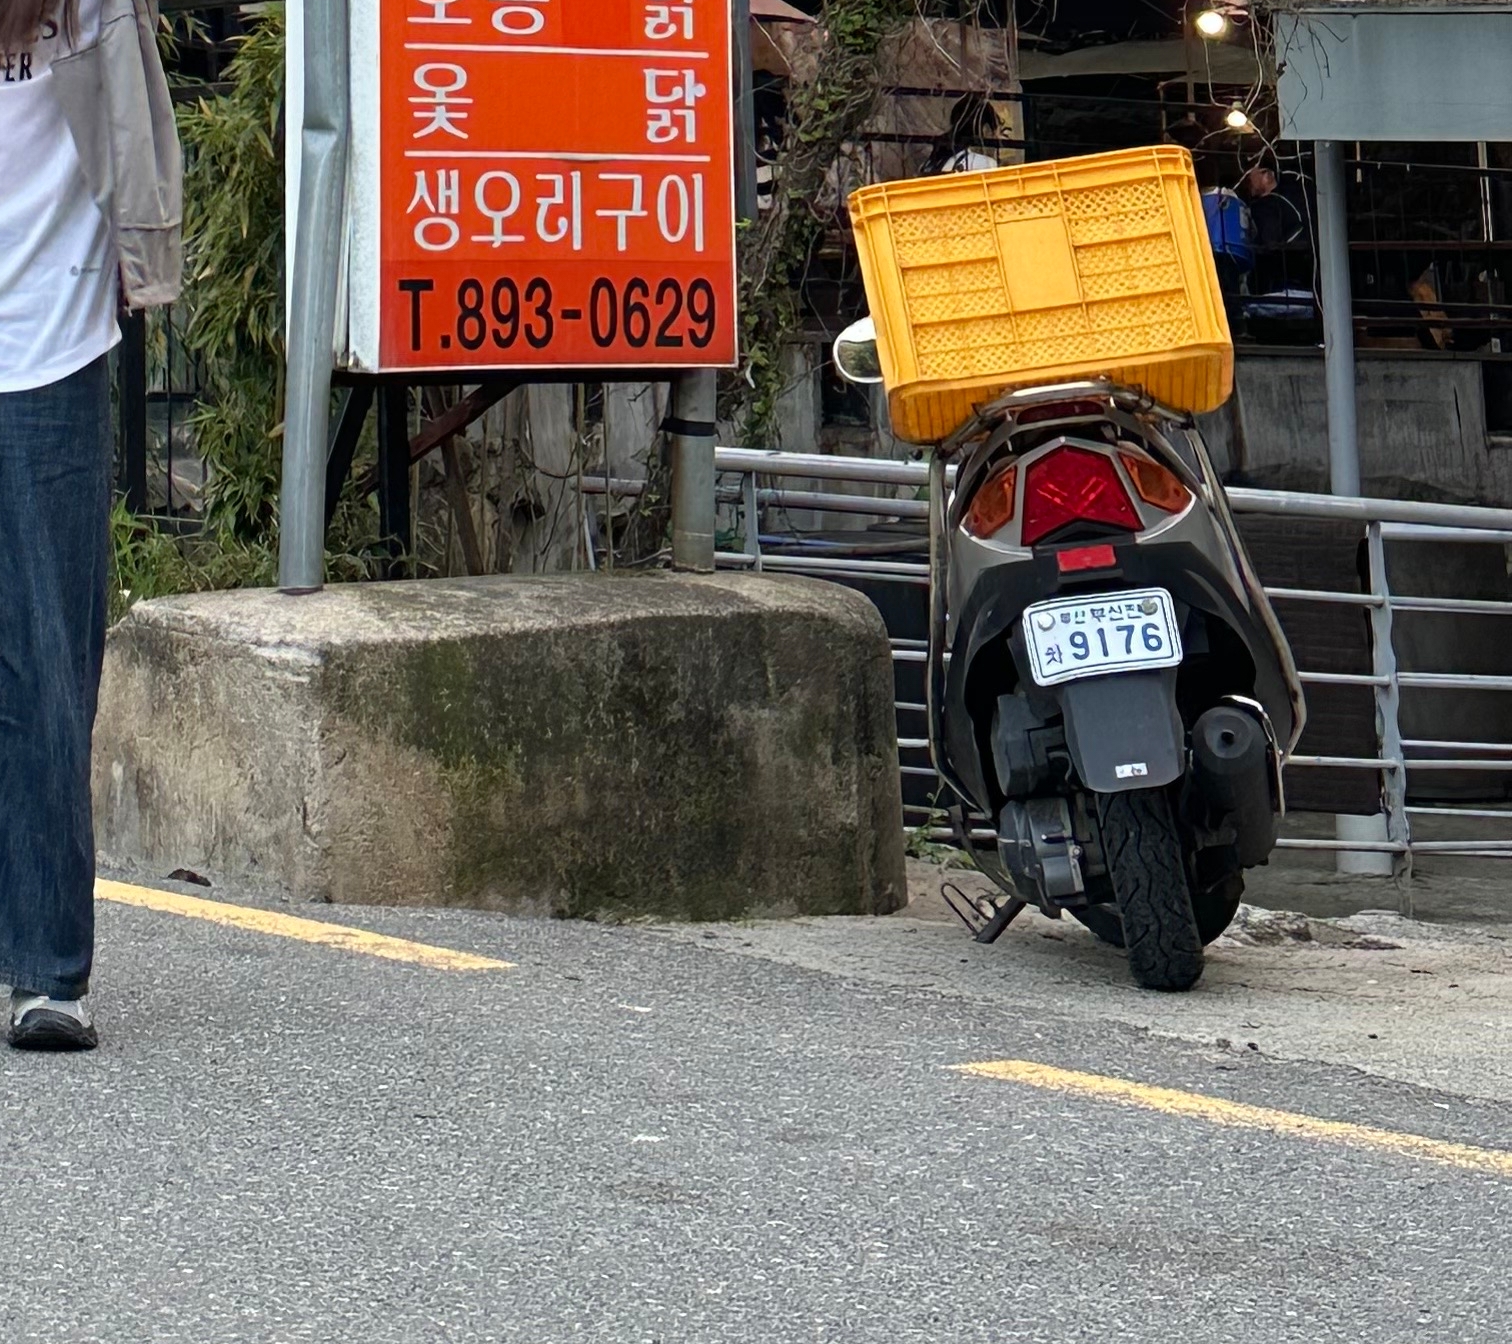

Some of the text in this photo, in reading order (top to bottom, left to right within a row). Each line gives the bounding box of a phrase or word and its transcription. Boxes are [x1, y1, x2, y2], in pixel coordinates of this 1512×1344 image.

[642, 67, 707, 144] 닭
[406, 168, 705, 252] 생오리구이
[398, 276, 716, 352] T.893-0629
[1044, 623, 1163, 666] 차 9176
